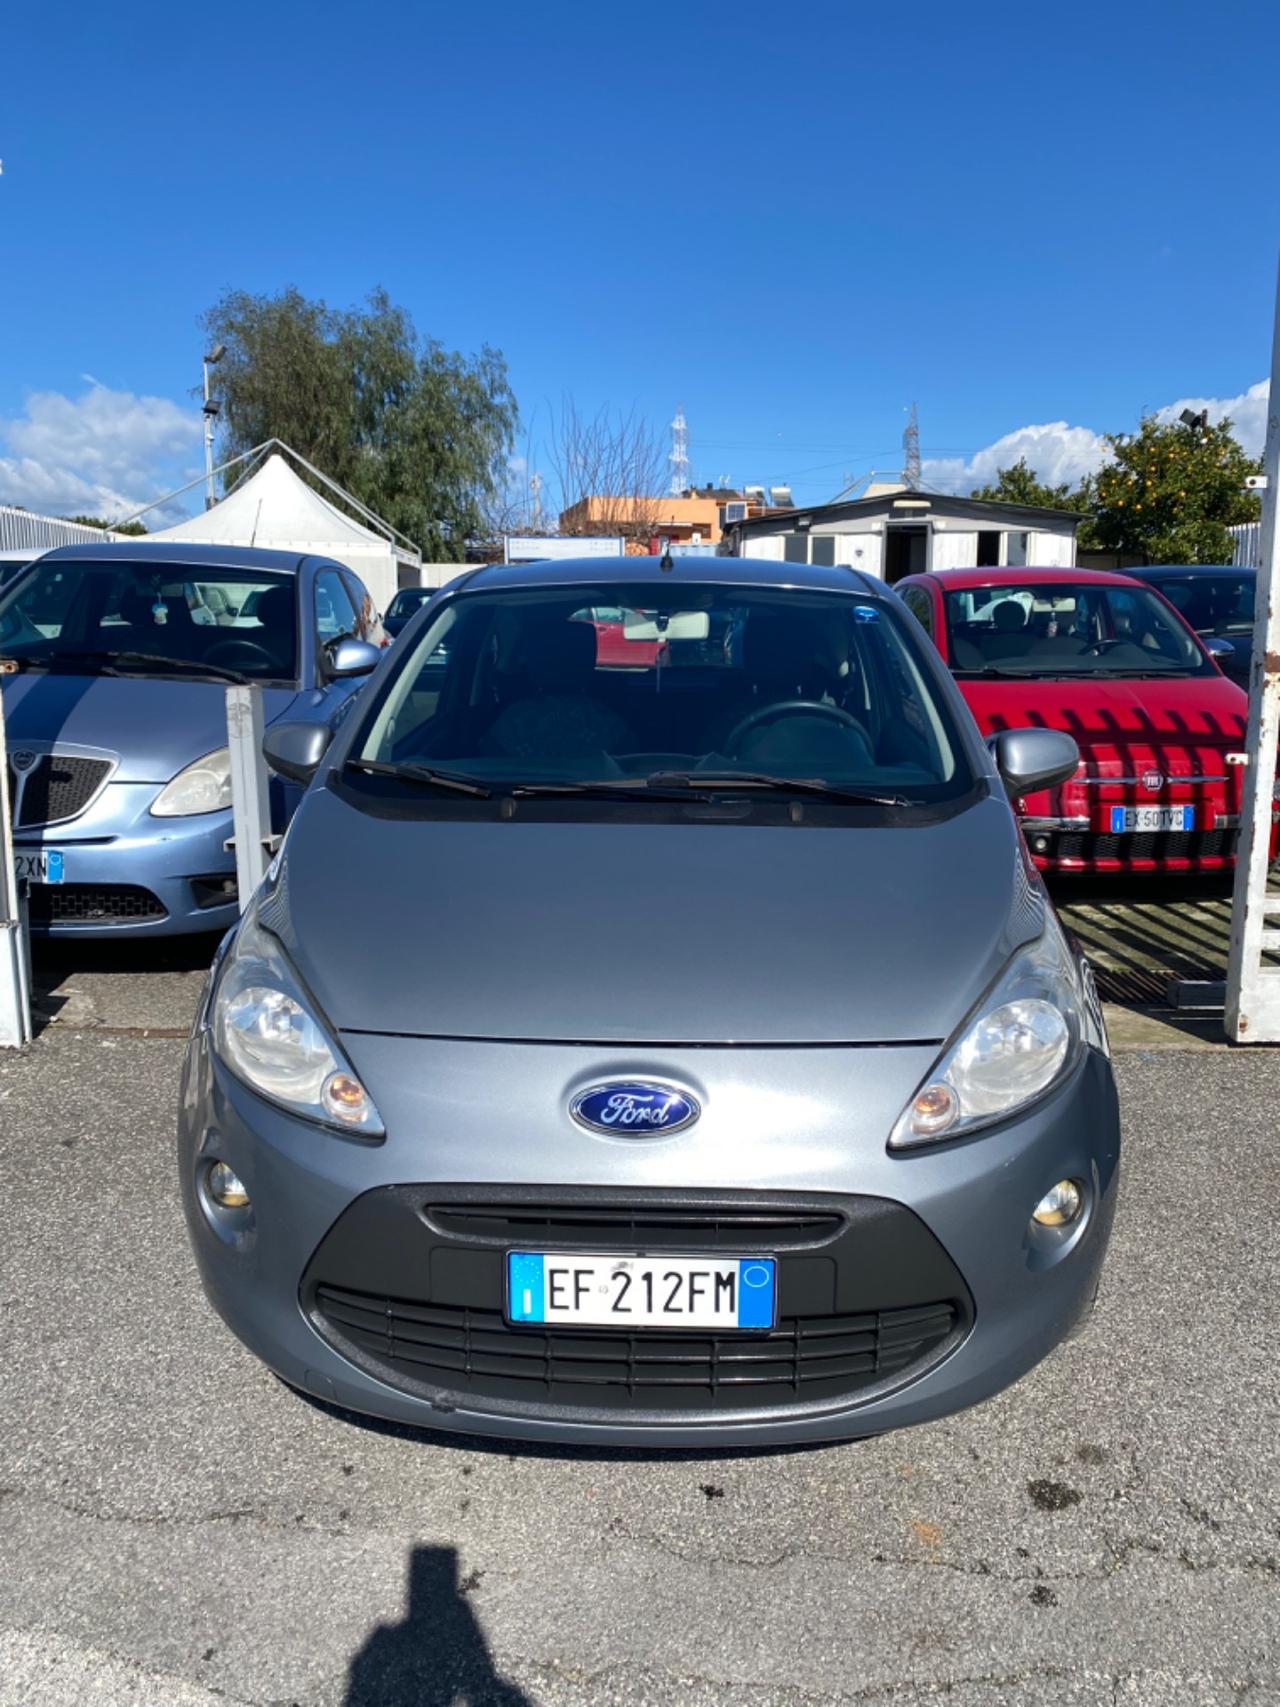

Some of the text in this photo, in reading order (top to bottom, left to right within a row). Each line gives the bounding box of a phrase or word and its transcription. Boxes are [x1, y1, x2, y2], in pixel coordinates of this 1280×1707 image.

[600, 1093, 672, 1124] Ford
[549, 1269, 595, 1310] EF
[611, 1271, 736, 1313] 212FM
